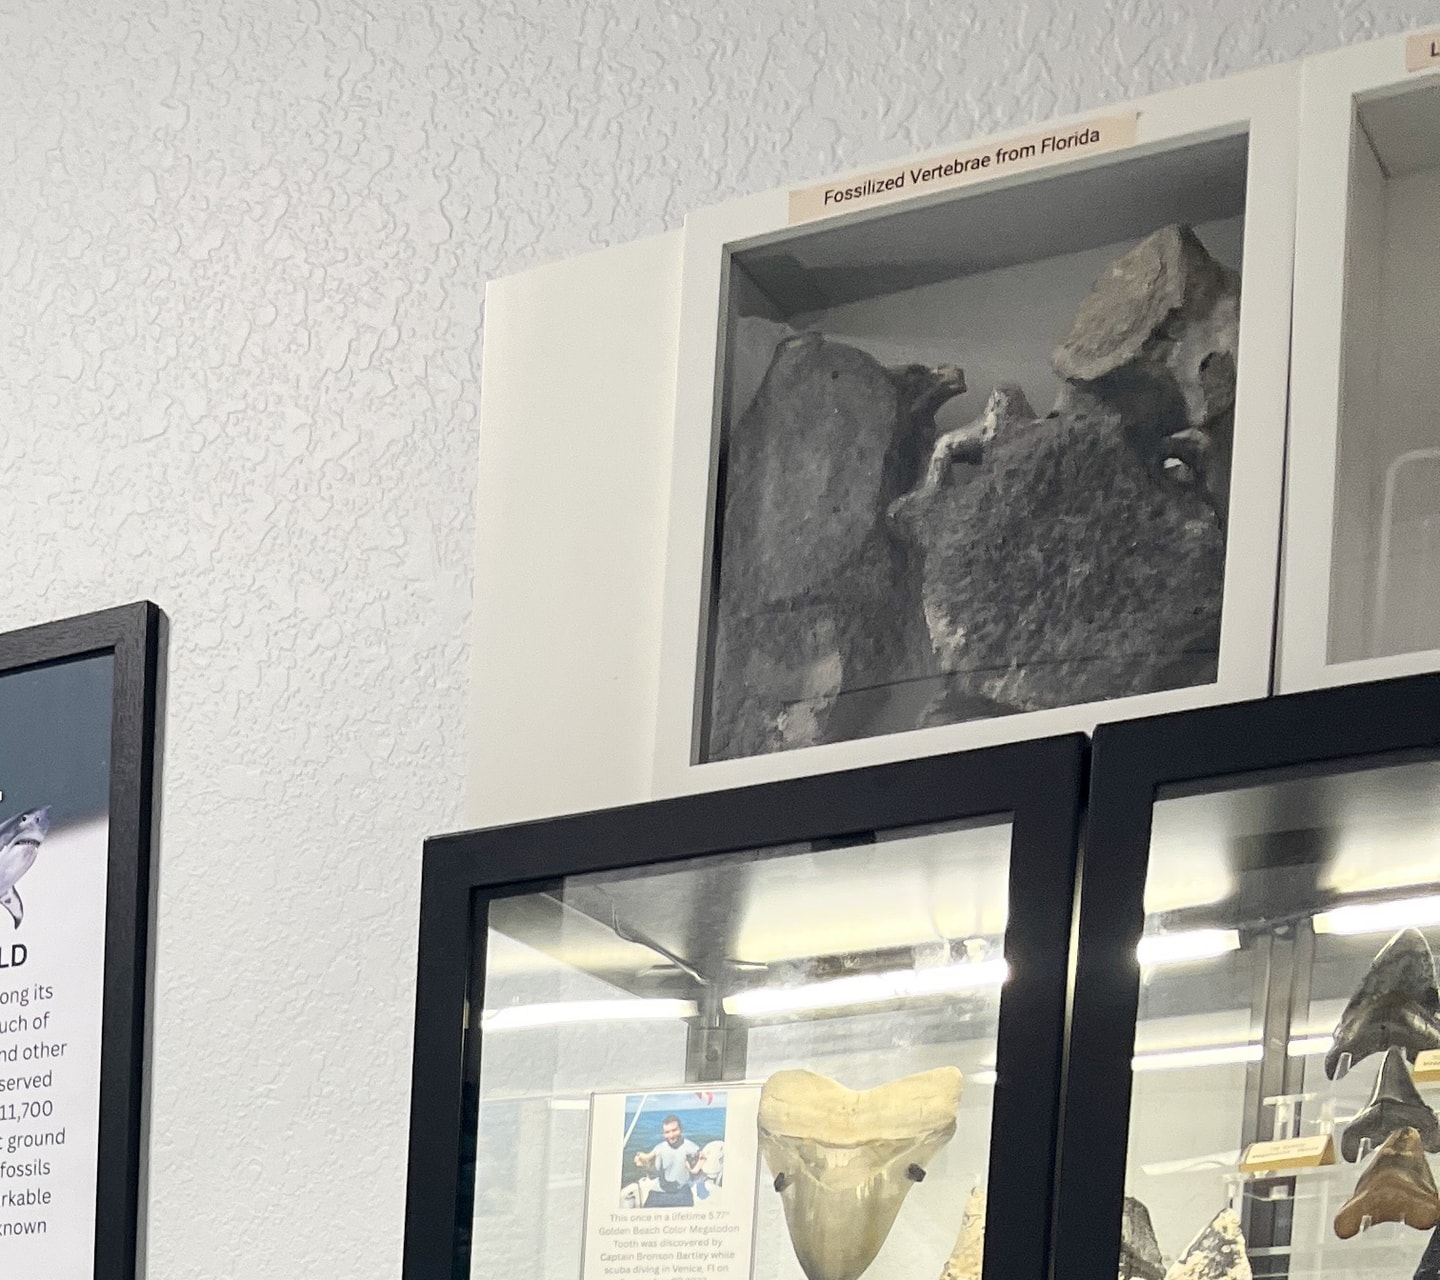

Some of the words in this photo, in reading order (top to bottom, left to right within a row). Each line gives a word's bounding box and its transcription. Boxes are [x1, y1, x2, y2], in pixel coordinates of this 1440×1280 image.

[823, 172, 906, 206] Fossilized
[910, 153, 992, 185] Vertebrae
[995, 144, 1036, 166] from
[1040, 127, 1101, 155] Florida
[33, 984, 53, 1000] its
[31, 1010, 50, 1030] of
